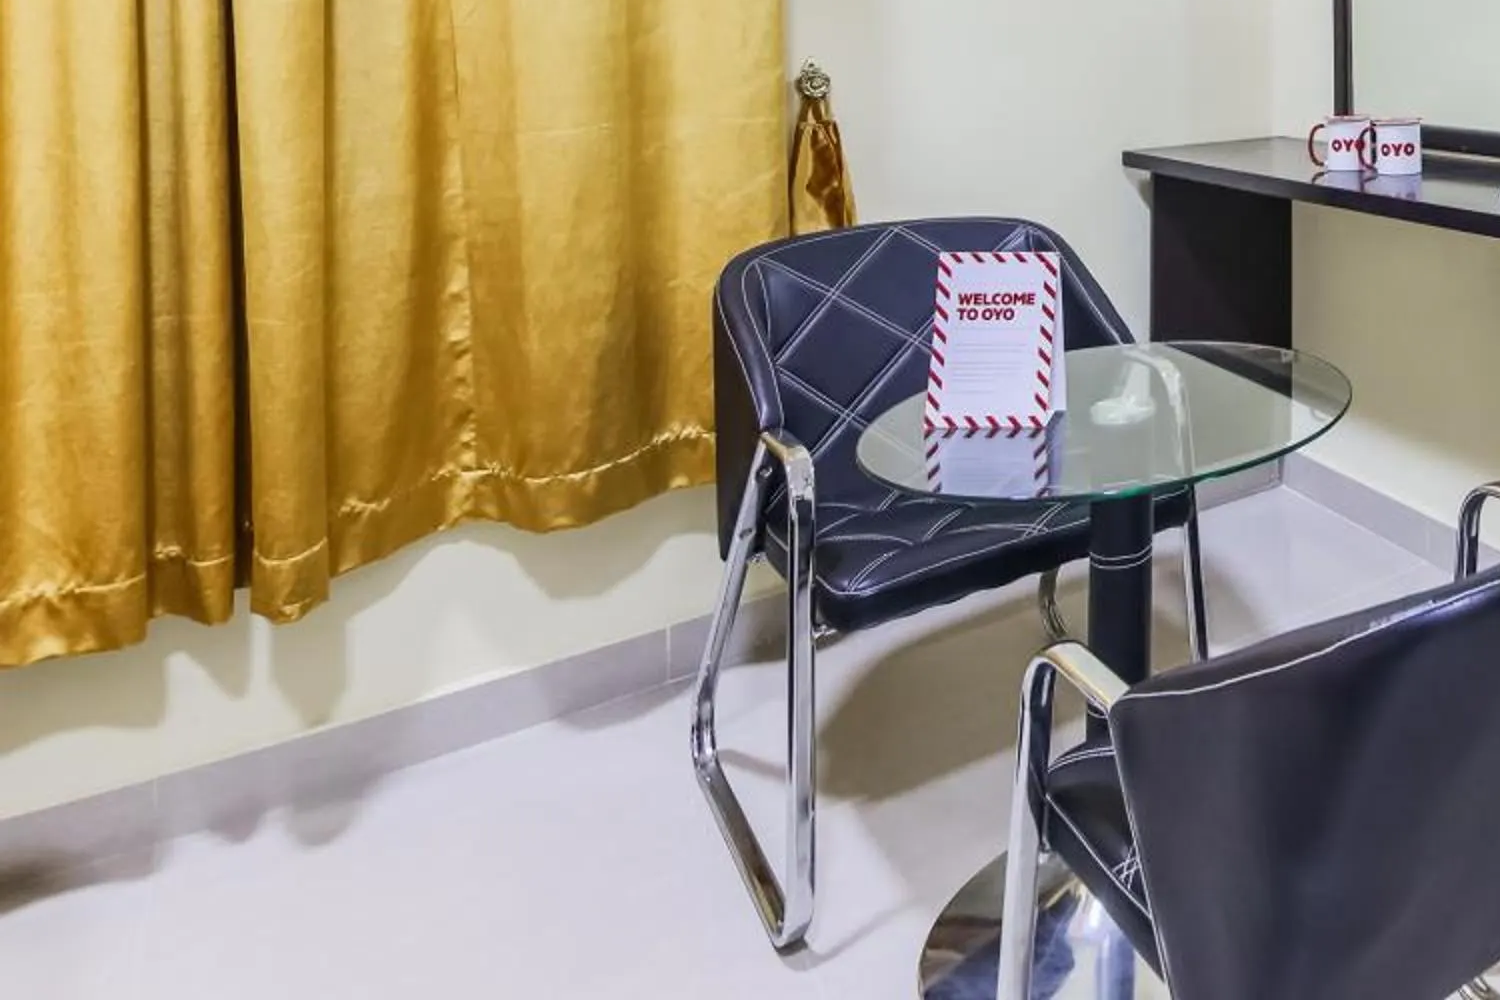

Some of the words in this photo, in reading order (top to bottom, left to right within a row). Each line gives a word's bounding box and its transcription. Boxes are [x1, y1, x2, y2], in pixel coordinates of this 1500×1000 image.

[1331, 139, 1366, 152] OYO
[1381, 142, 1415, 157] OYO
[958, 292, 1036, 306] WELCOME
[957, 308, 979, 321] TO
[982, 307, 1015, 321] OYO
